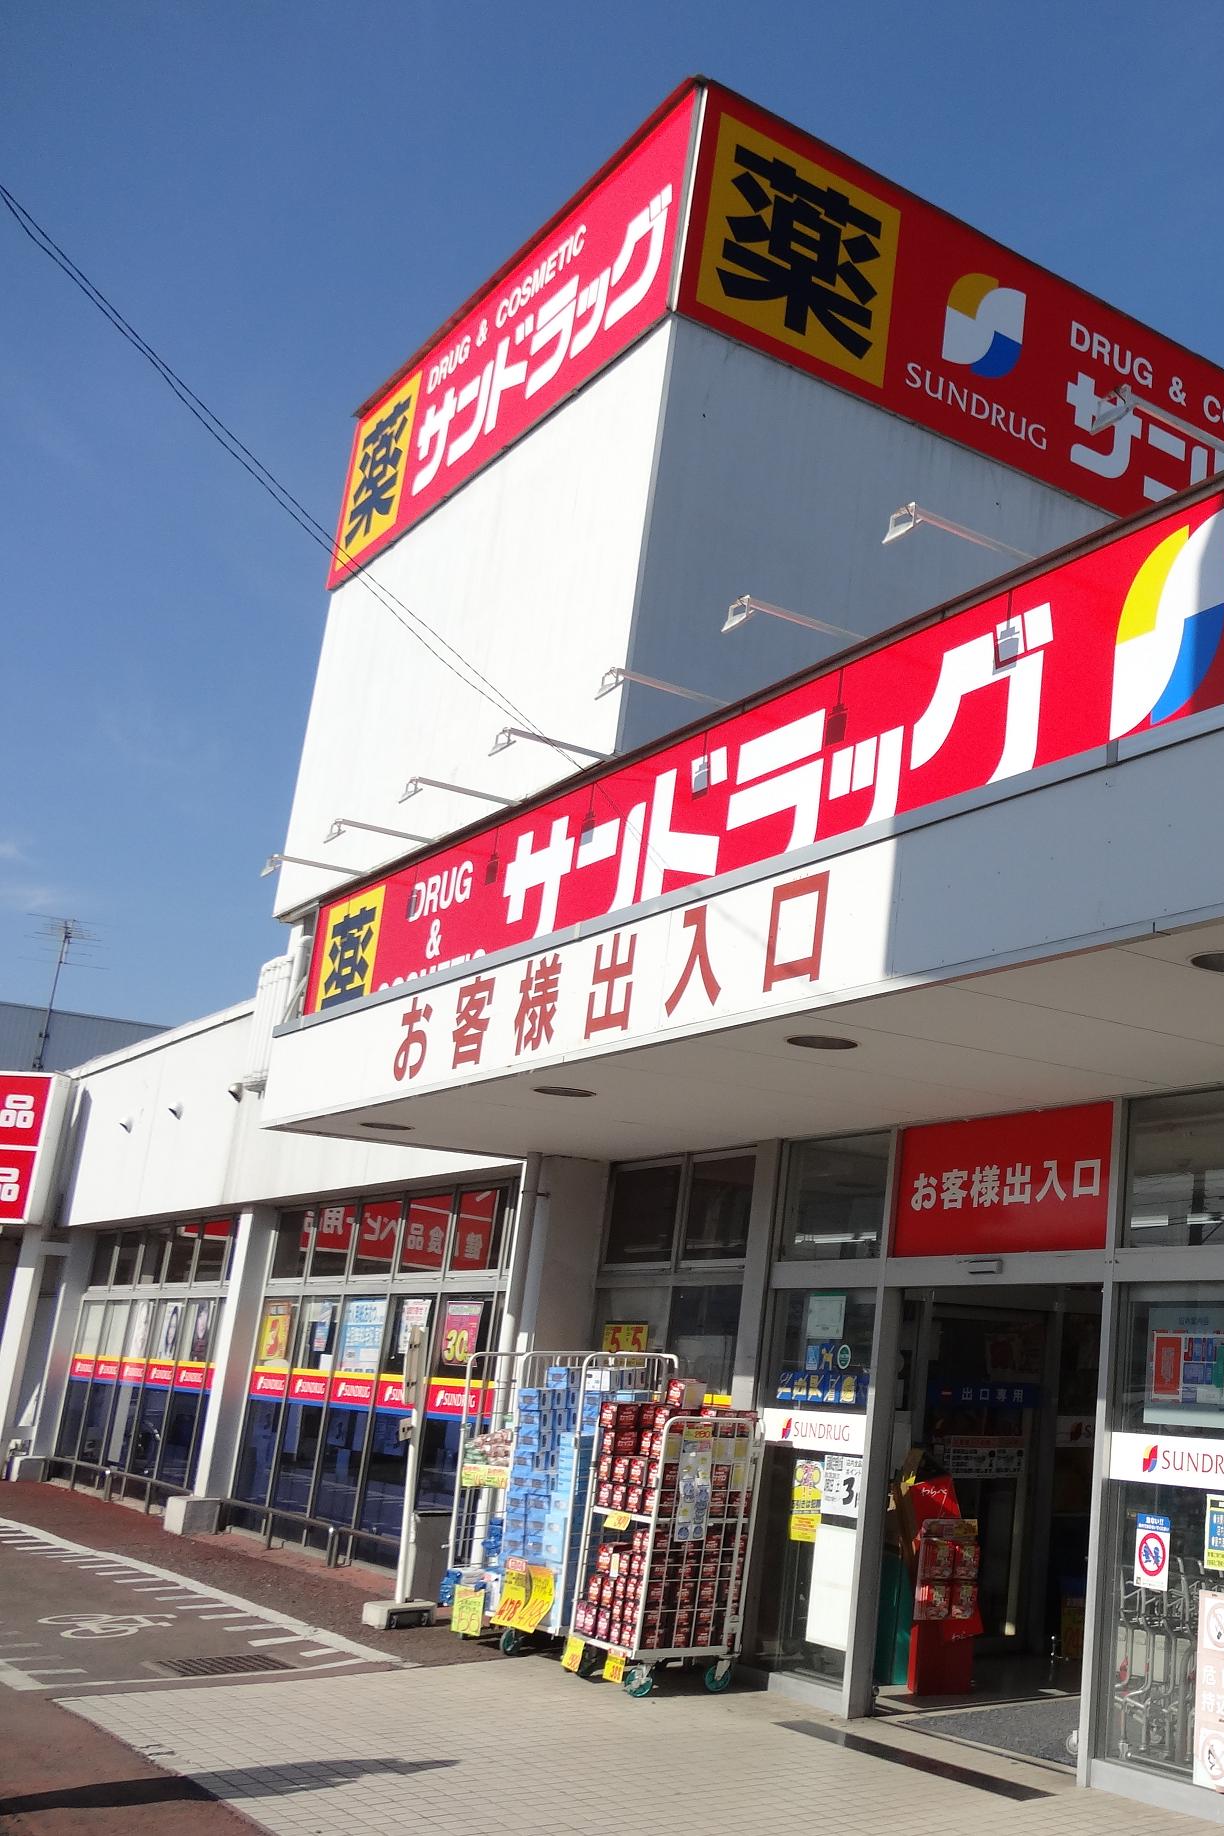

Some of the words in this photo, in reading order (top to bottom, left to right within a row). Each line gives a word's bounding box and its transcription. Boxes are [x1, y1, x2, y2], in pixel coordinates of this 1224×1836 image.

[714, 143, 882, 359] 薬
[411, 183, 673, 497] サンドラッグ
[426, 336, 472, 394] DRUG
[475, 322, 489, 349] &
[494, 224, 588, 328] COSMETIC
[1069, 319, 1155, 388] DRUG
[1167, 375, 1188, 407] &
[904, 361, 1048, 452] SUNDRUG
[344, 393, 413, 548] 薬
[502, 600, 1054, 940] サンドラッグ
[408, 860, 474, 923] DRUG
[321, 905, 377, 1012] 薬
[425, 918, 442, 960] &
[392, 871, 831, 1083] お客様出入口
[0, 1093, 35, 1129] 品
[910, 1157, 1102, 1214] お客様出入口
[445, 1330, 468, 1362] 30
[443, 1392, 477, 1408] SUNDUG
[793, 1421, 851, 1442] SUNDRUG
[961, 1387, 1024, 1403] 出口専用
[843, 1476, 856, 1506] 3
